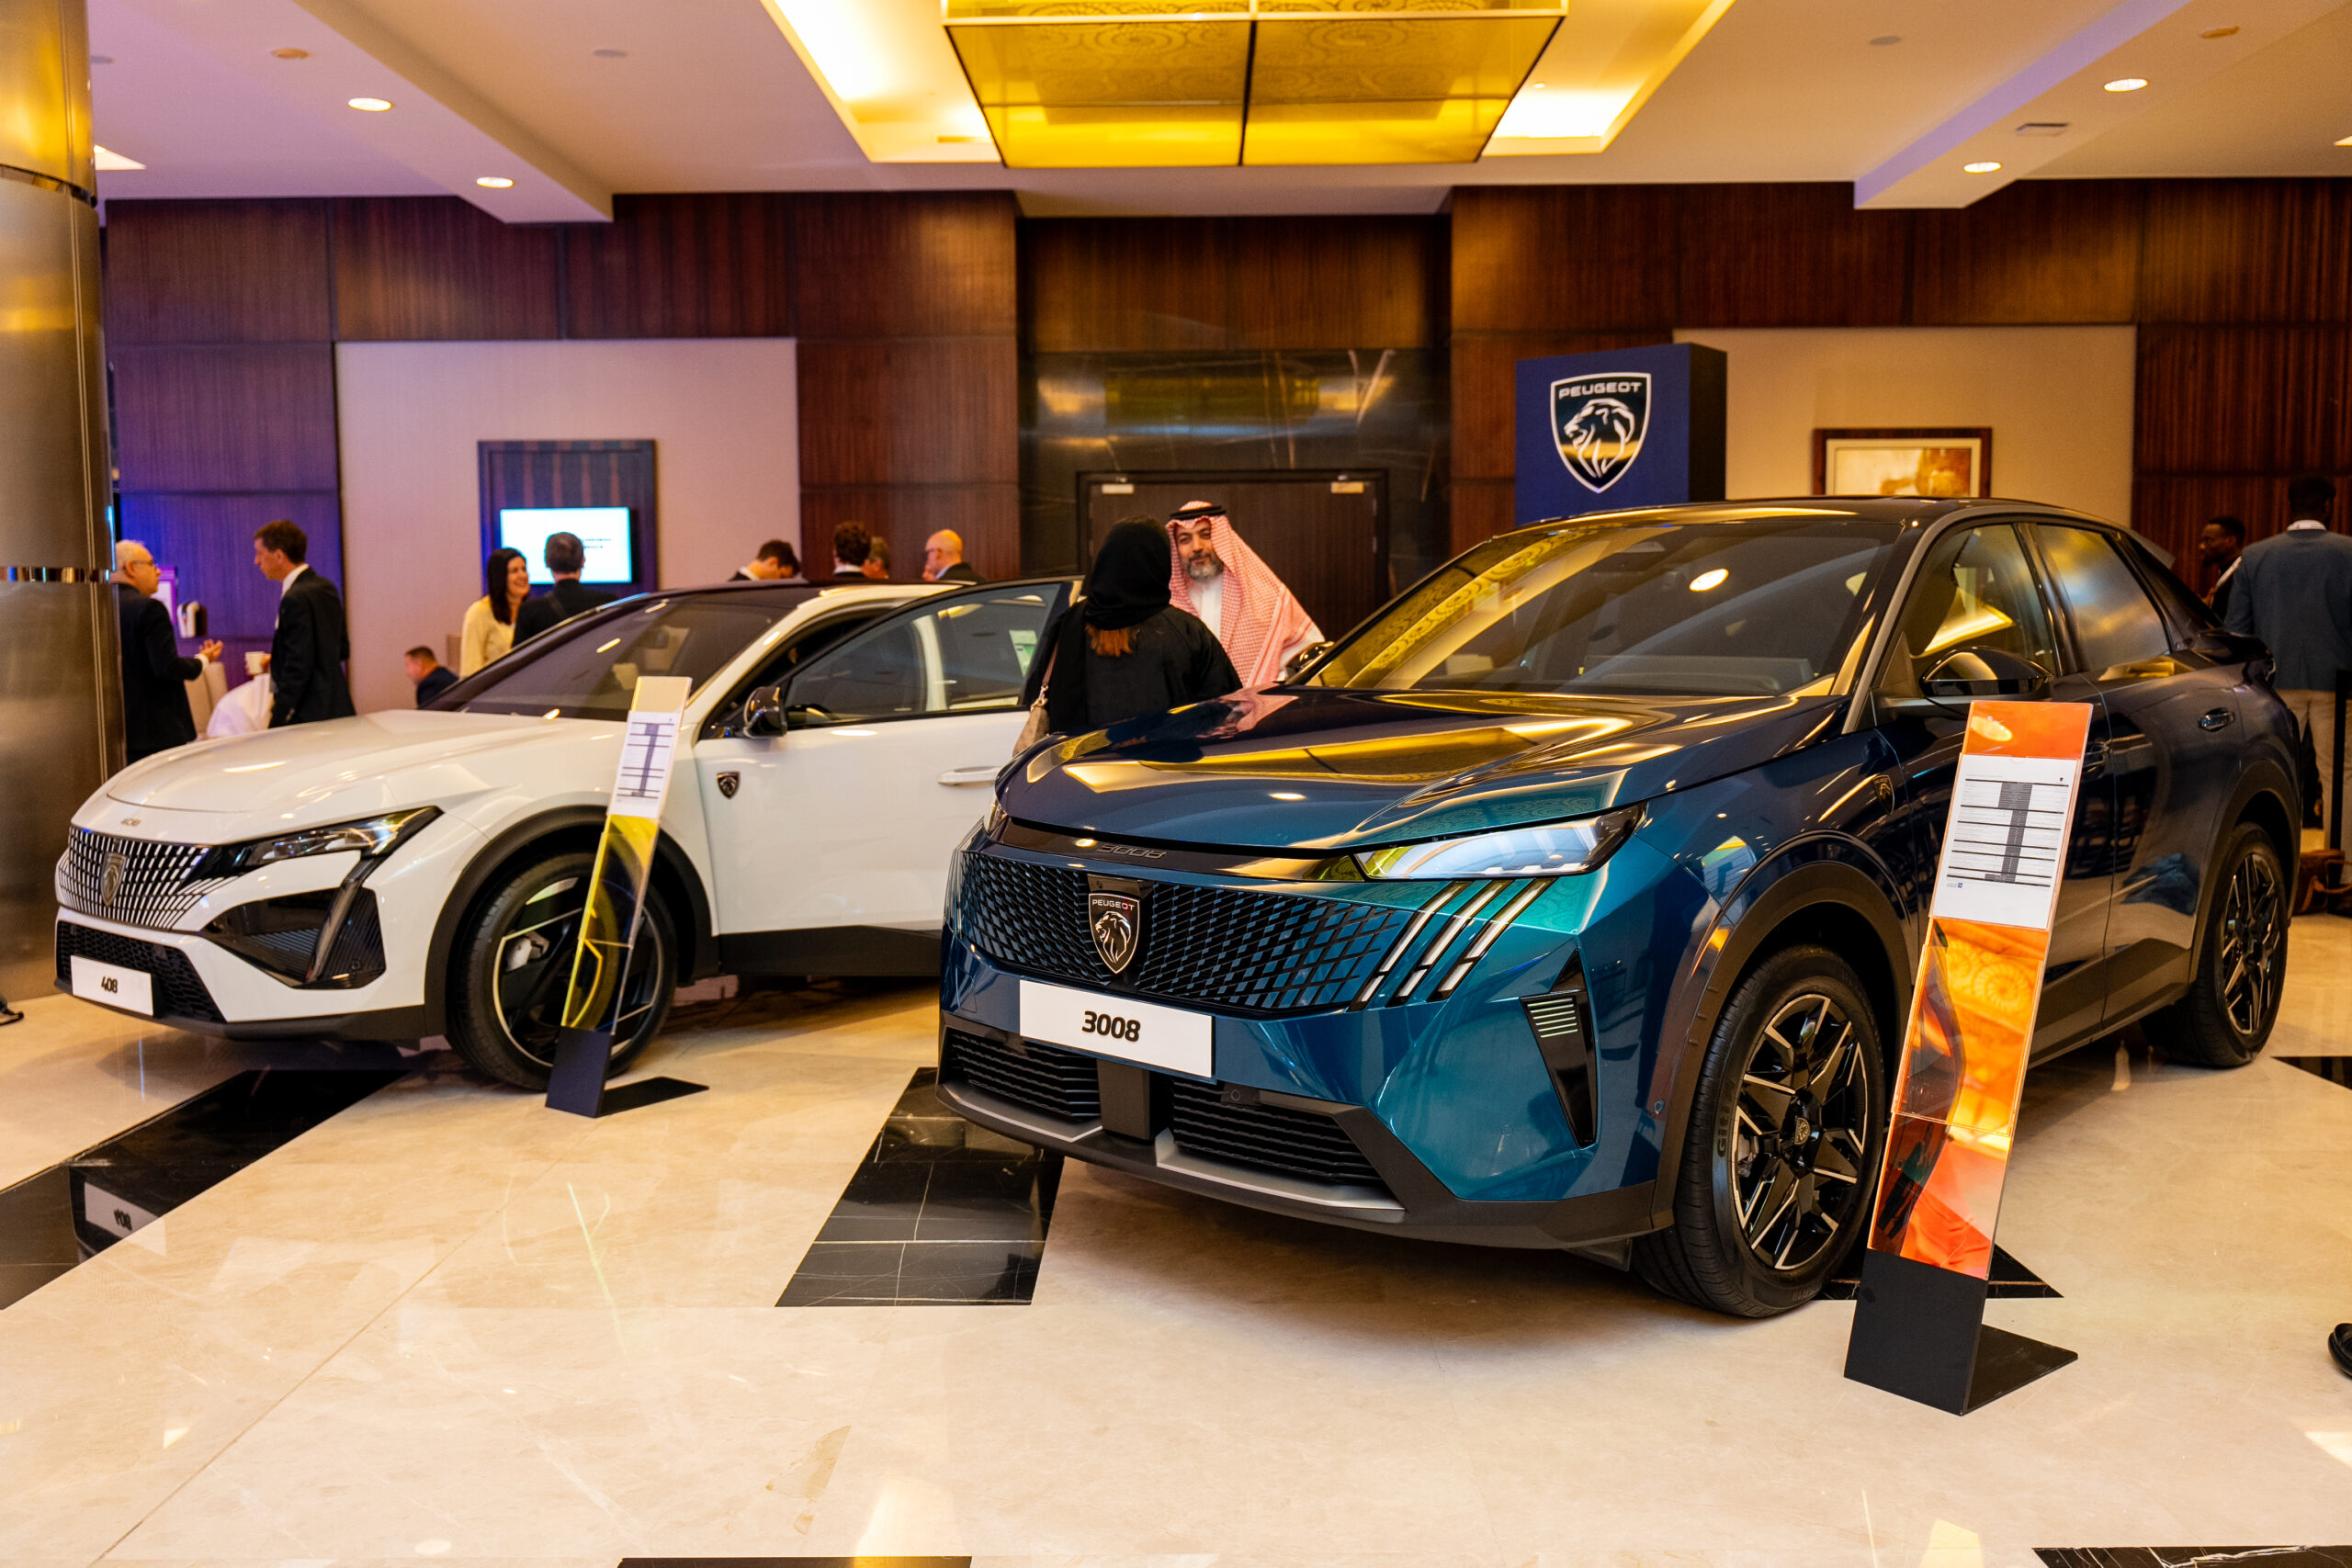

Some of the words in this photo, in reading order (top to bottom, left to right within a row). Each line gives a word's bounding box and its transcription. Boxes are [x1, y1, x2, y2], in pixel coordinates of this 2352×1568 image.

[1558, 381, 1643, 400] PEUGEOT
[1097, 844, 1167, 859] 3008
[1091, 899, 1135, 911] PEUGEOT
[101, 976, 118, 993] 408
[1081, 1010, 1141, 1042] 3008
